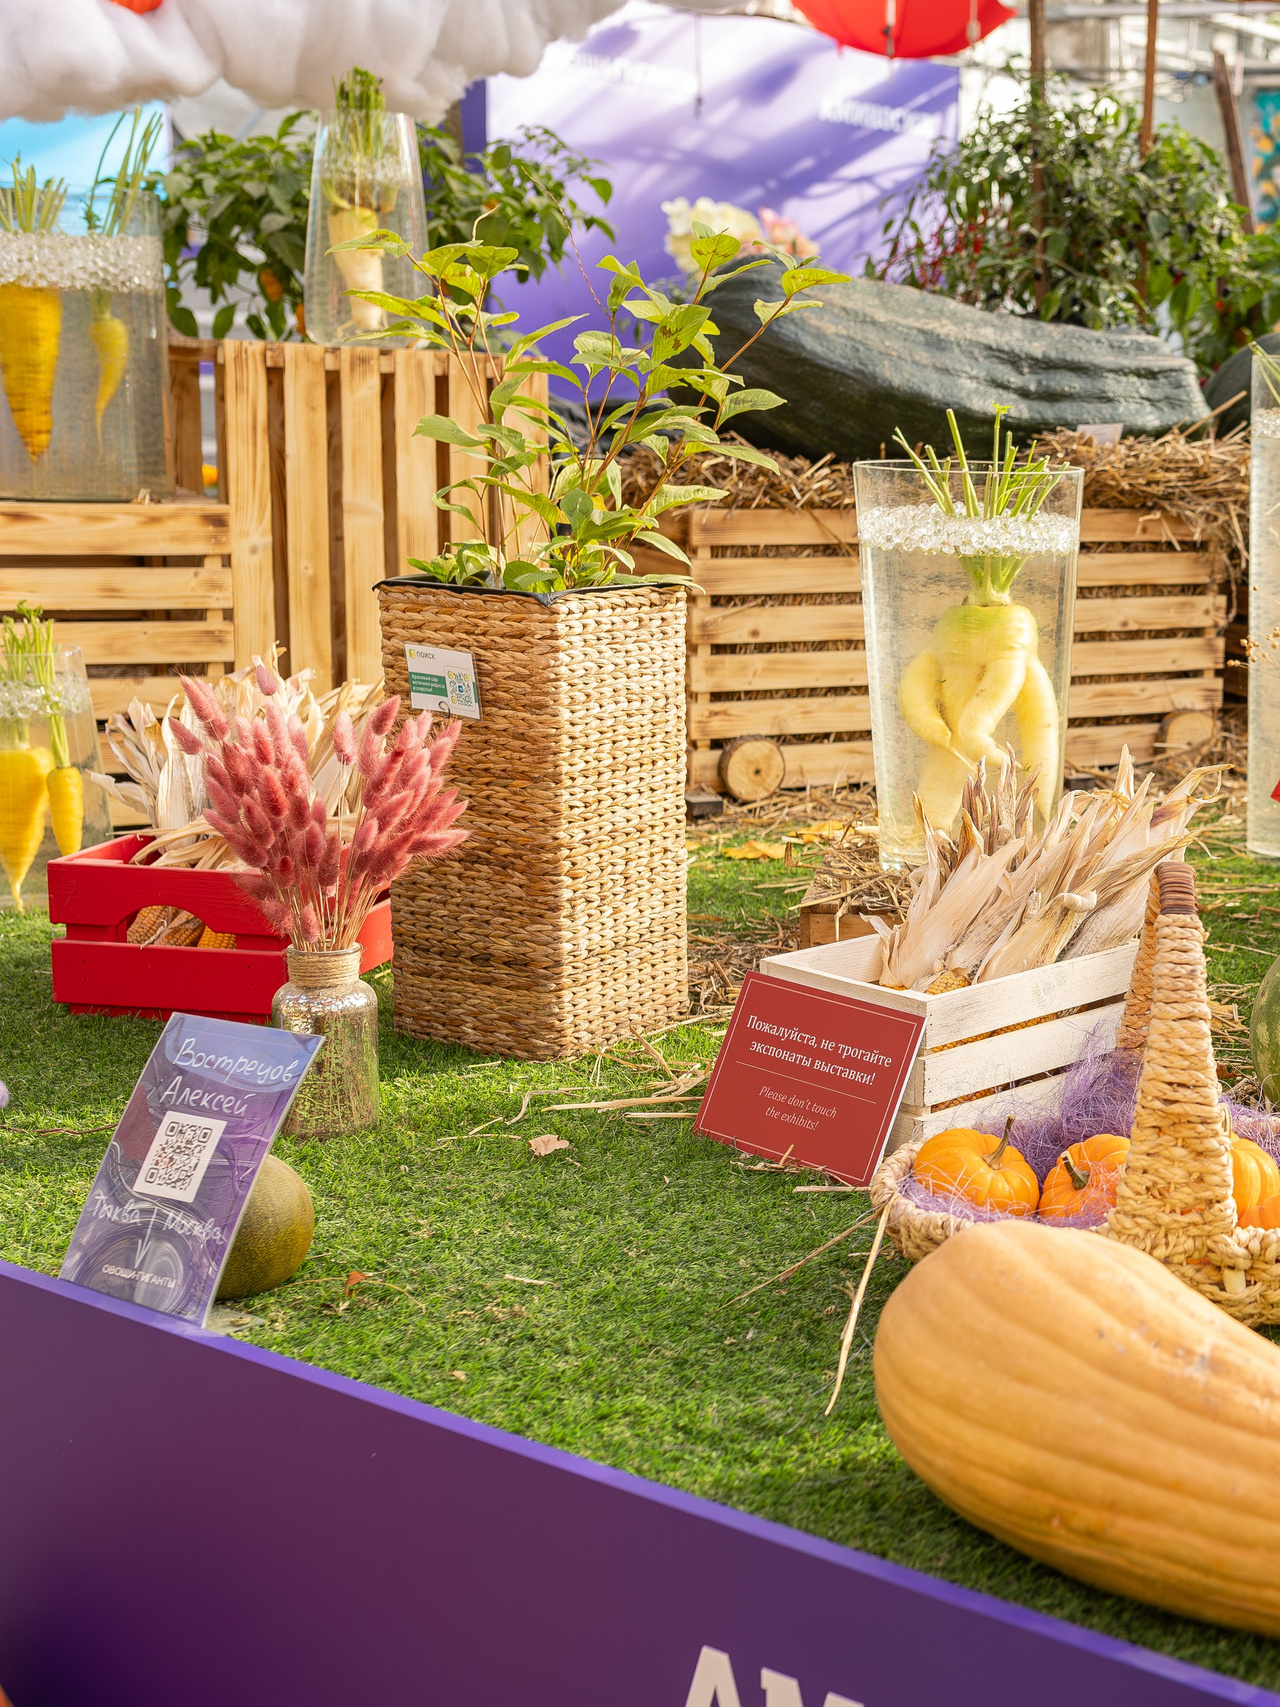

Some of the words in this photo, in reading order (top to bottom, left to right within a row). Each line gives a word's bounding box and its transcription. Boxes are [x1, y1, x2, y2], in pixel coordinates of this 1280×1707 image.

[416, 651, 436, 660] ПОИСК
[746, 1014, 818, 1050] Пожалуйста,
[820, 1038, 836, 1051] не
[838, 1042, 892, 1068] трогайте
[749, 1041, 811, 1068] экспонаты
[813, 1057, 876, 1086] выставки!
[159, 1075, 257, 1117] Алексей
[758, 1085, 787, 1103] Please
[812, 1099, 837, 1119] touch
[765, 1106, 781, 1120] the
[781, 1111, 820, 1131] exhibits!
